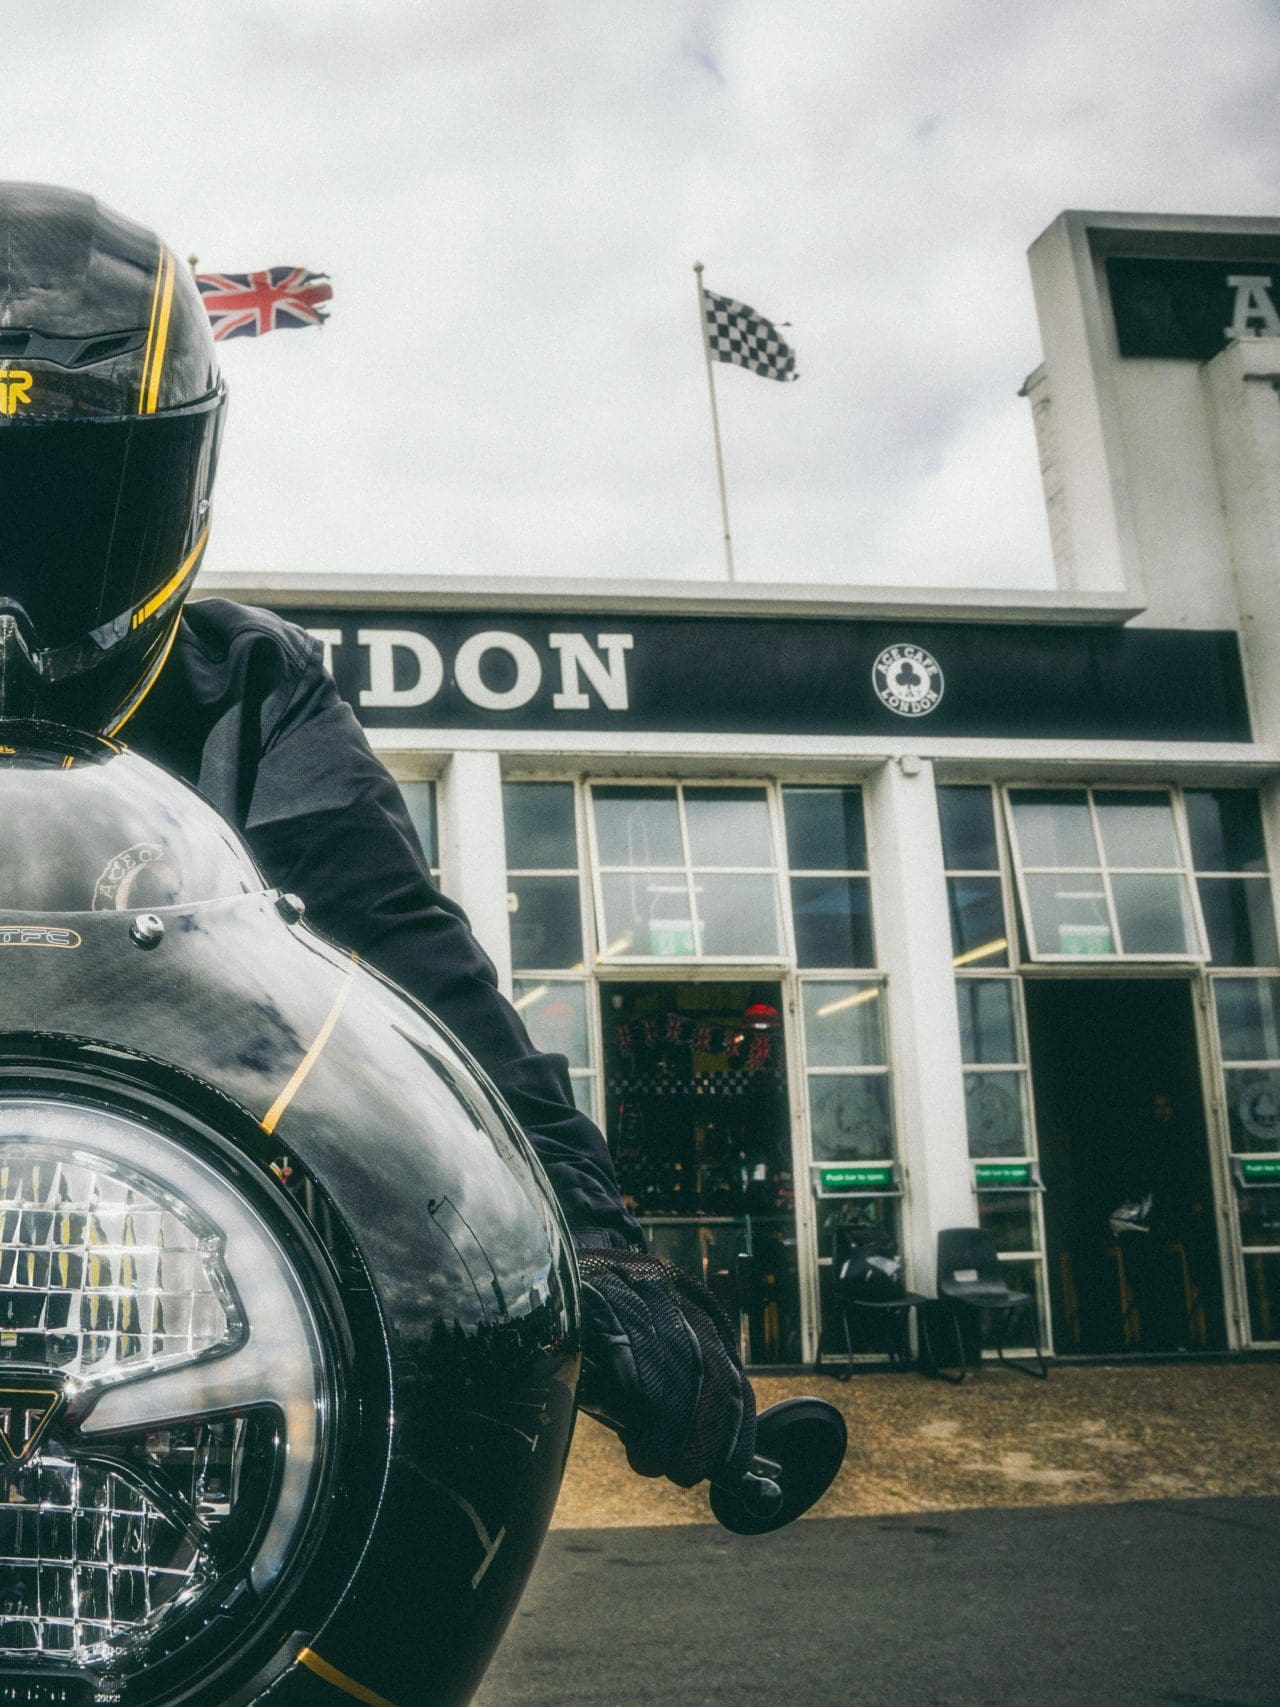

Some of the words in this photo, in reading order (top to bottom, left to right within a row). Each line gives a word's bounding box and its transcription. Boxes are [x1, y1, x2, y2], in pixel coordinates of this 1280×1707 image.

[877, 648, 901, 675] ACE
[904, 647, 939, 677] CAFE
[880, 689, 938, 714] LONDON
